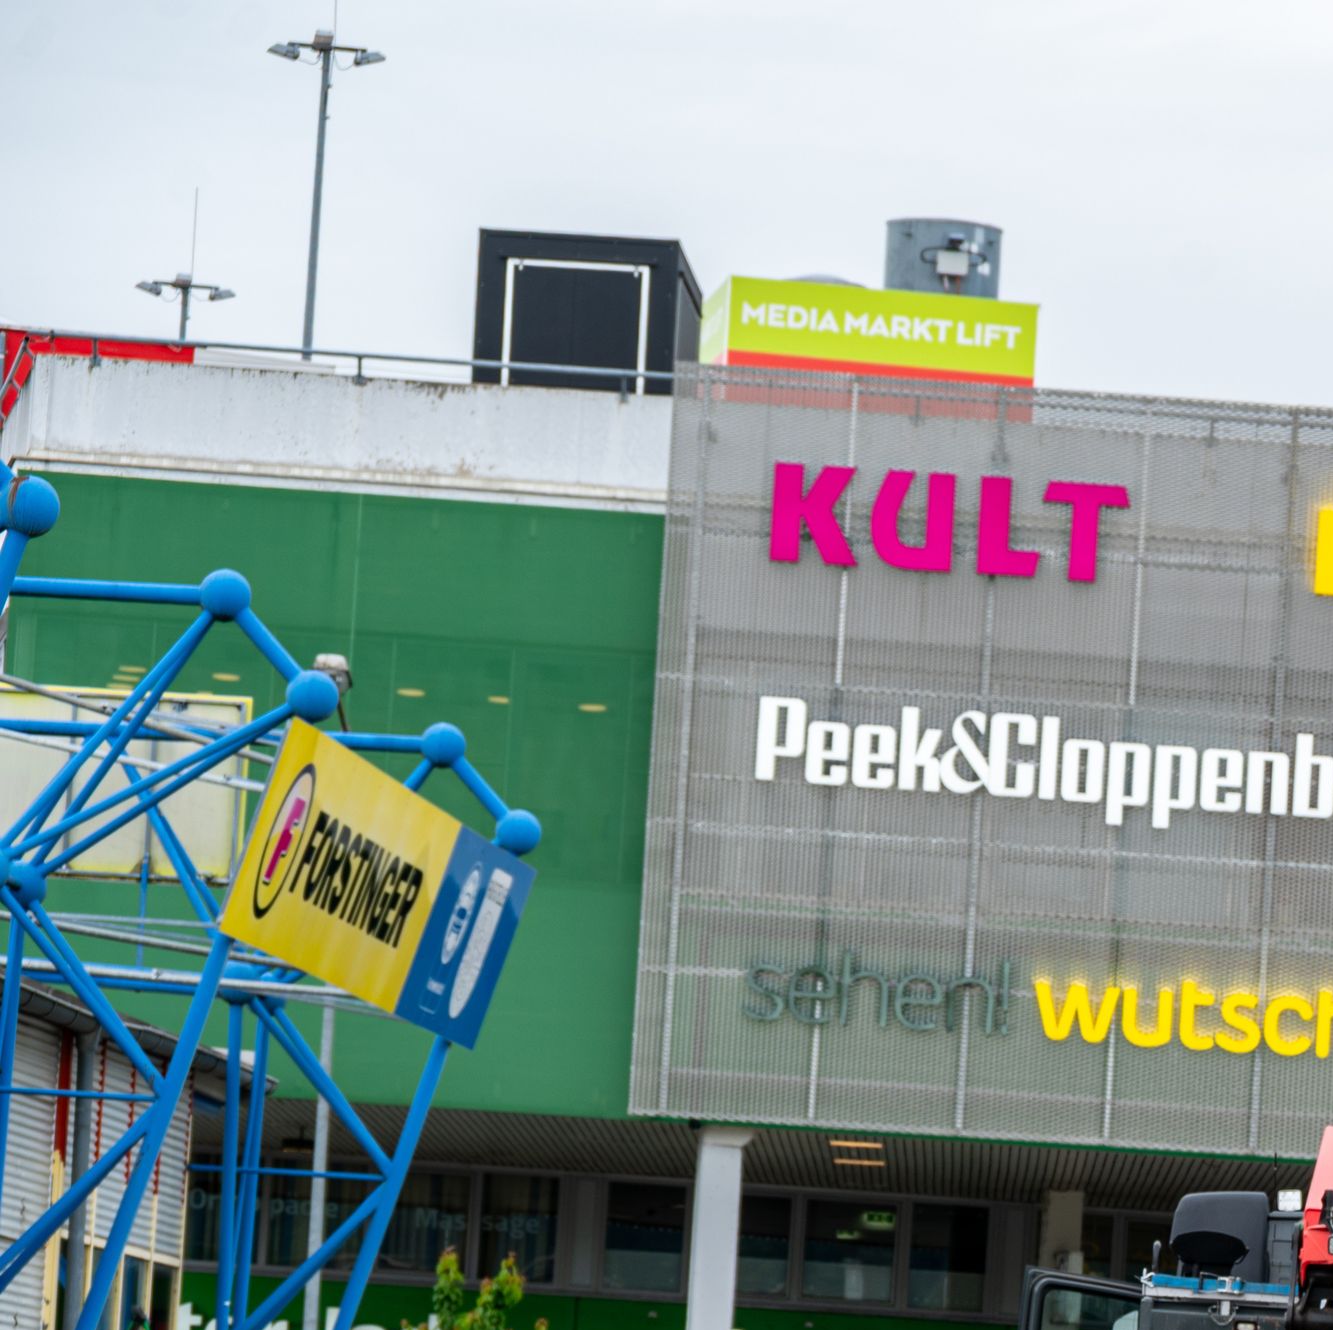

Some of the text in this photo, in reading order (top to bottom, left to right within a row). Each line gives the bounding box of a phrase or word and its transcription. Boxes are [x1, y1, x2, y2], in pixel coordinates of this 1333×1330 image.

[741, 301, 839, 334] MEDIA
[844, 311, 953, 343] MARKT
[956, 322, 1021, 350] LIFT
[769, 461, 1131, 583] KULT
[288, 810, 424, 949] FORSTINGER
[742, 950, 1010, 1036] sehen!
